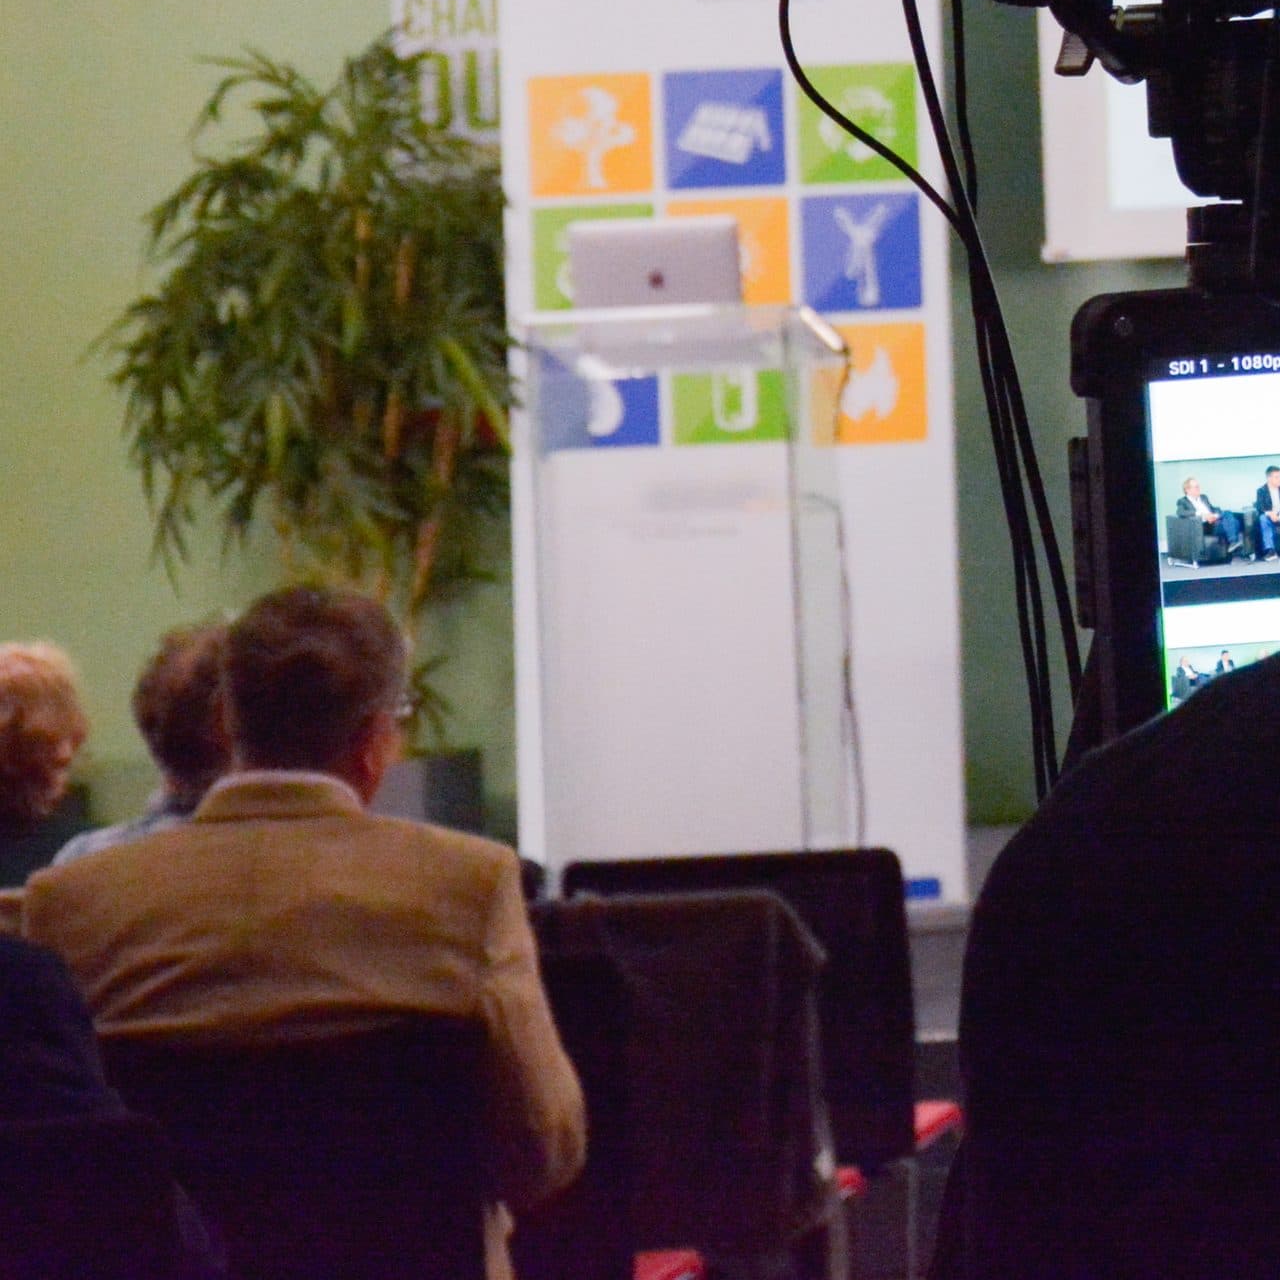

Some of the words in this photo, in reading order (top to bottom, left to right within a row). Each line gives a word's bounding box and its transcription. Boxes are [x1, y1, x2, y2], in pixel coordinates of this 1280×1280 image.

[408, 49, 500, 131] OU
[1169, 360, 1195, 375] SDI
[1200, 358, 1208, 373] 1
